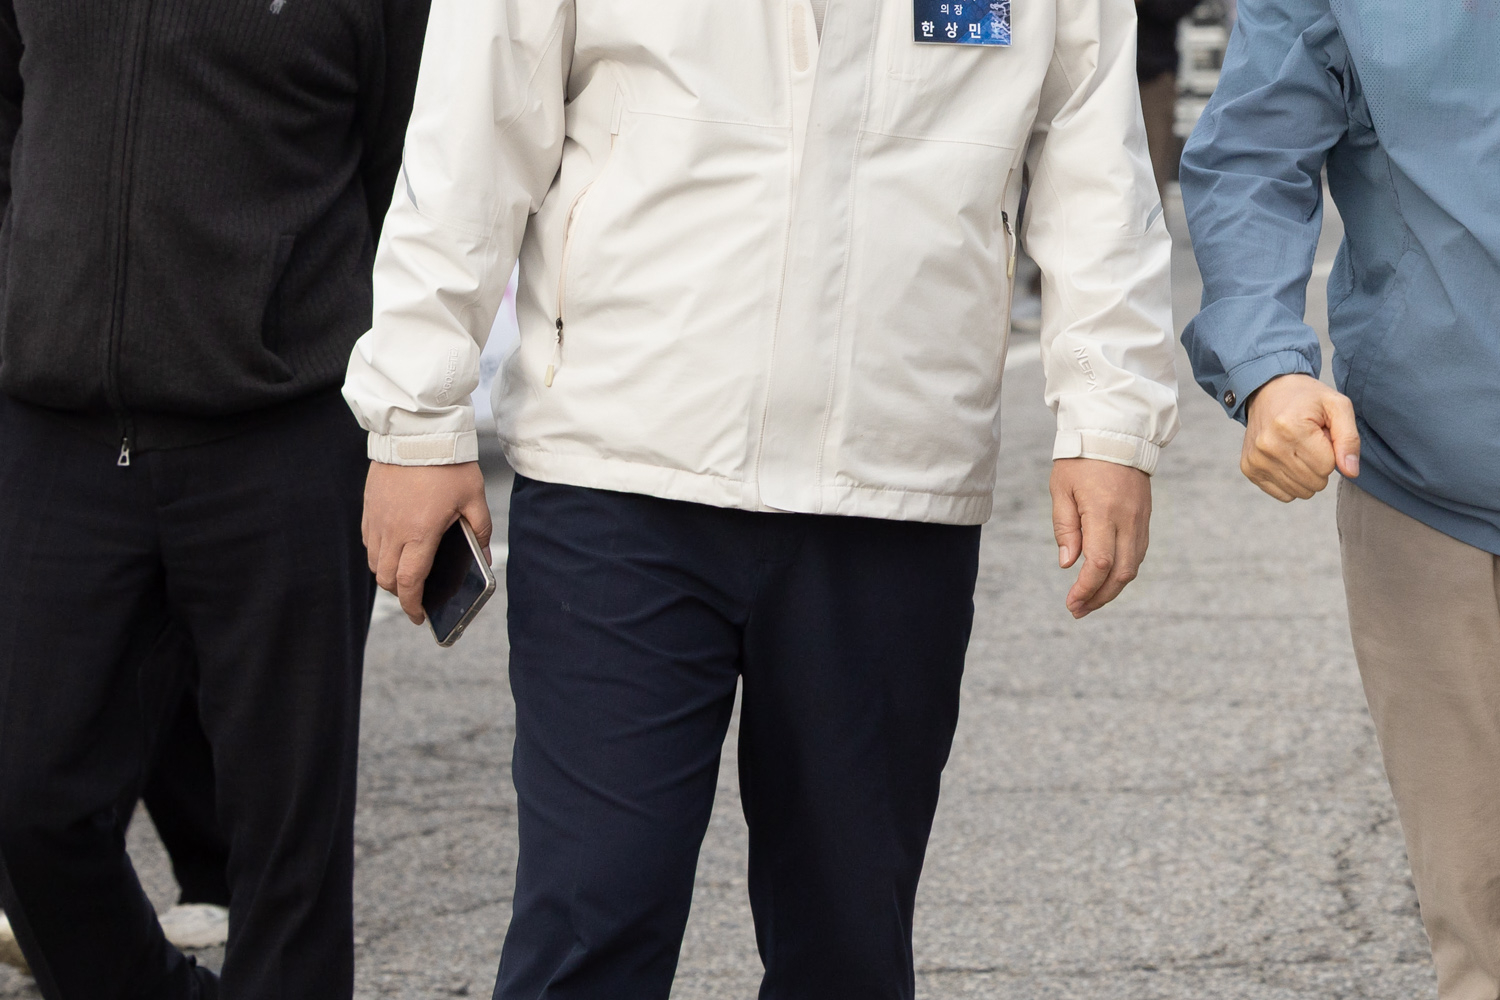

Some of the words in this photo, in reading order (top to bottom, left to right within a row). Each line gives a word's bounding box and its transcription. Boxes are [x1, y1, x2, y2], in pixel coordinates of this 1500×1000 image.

[940, 4, 963, 16] 의장
[921, 20, 982, 39] 한상민
[1073, 345, 1098, 393] NEPA
